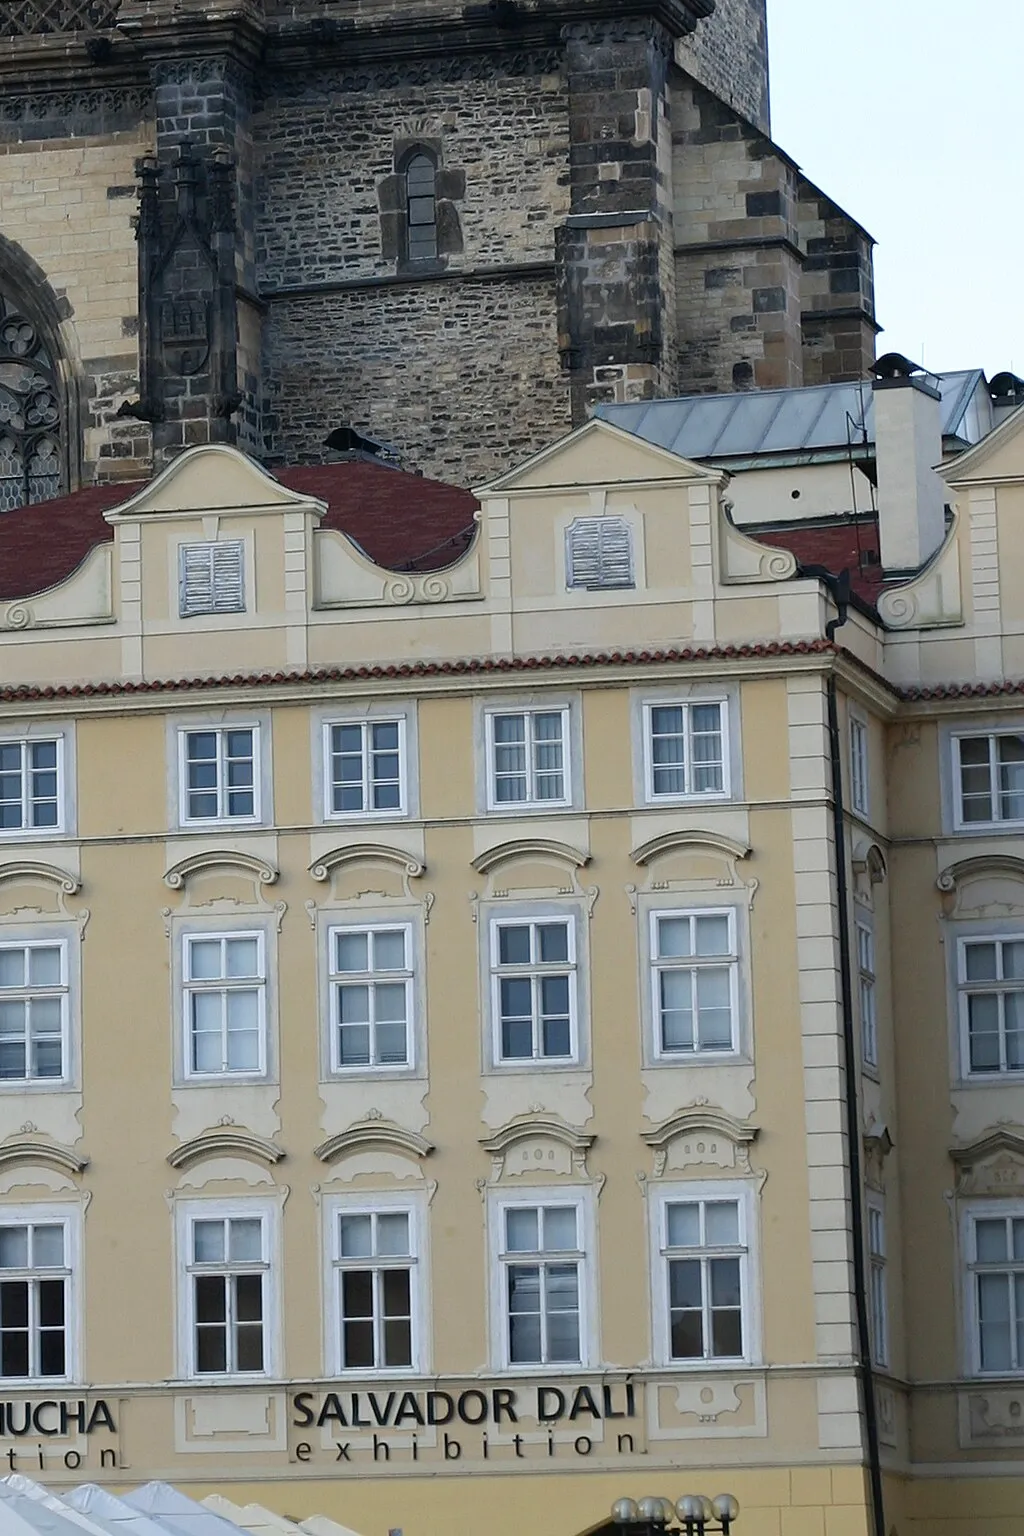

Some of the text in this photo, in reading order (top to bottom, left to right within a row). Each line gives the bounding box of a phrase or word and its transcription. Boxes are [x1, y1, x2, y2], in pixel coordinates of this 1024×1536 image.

[293, 1373, 636, 1427] SALVADOR DALÍ
[295, 1429, 634, 1462] exhibition
